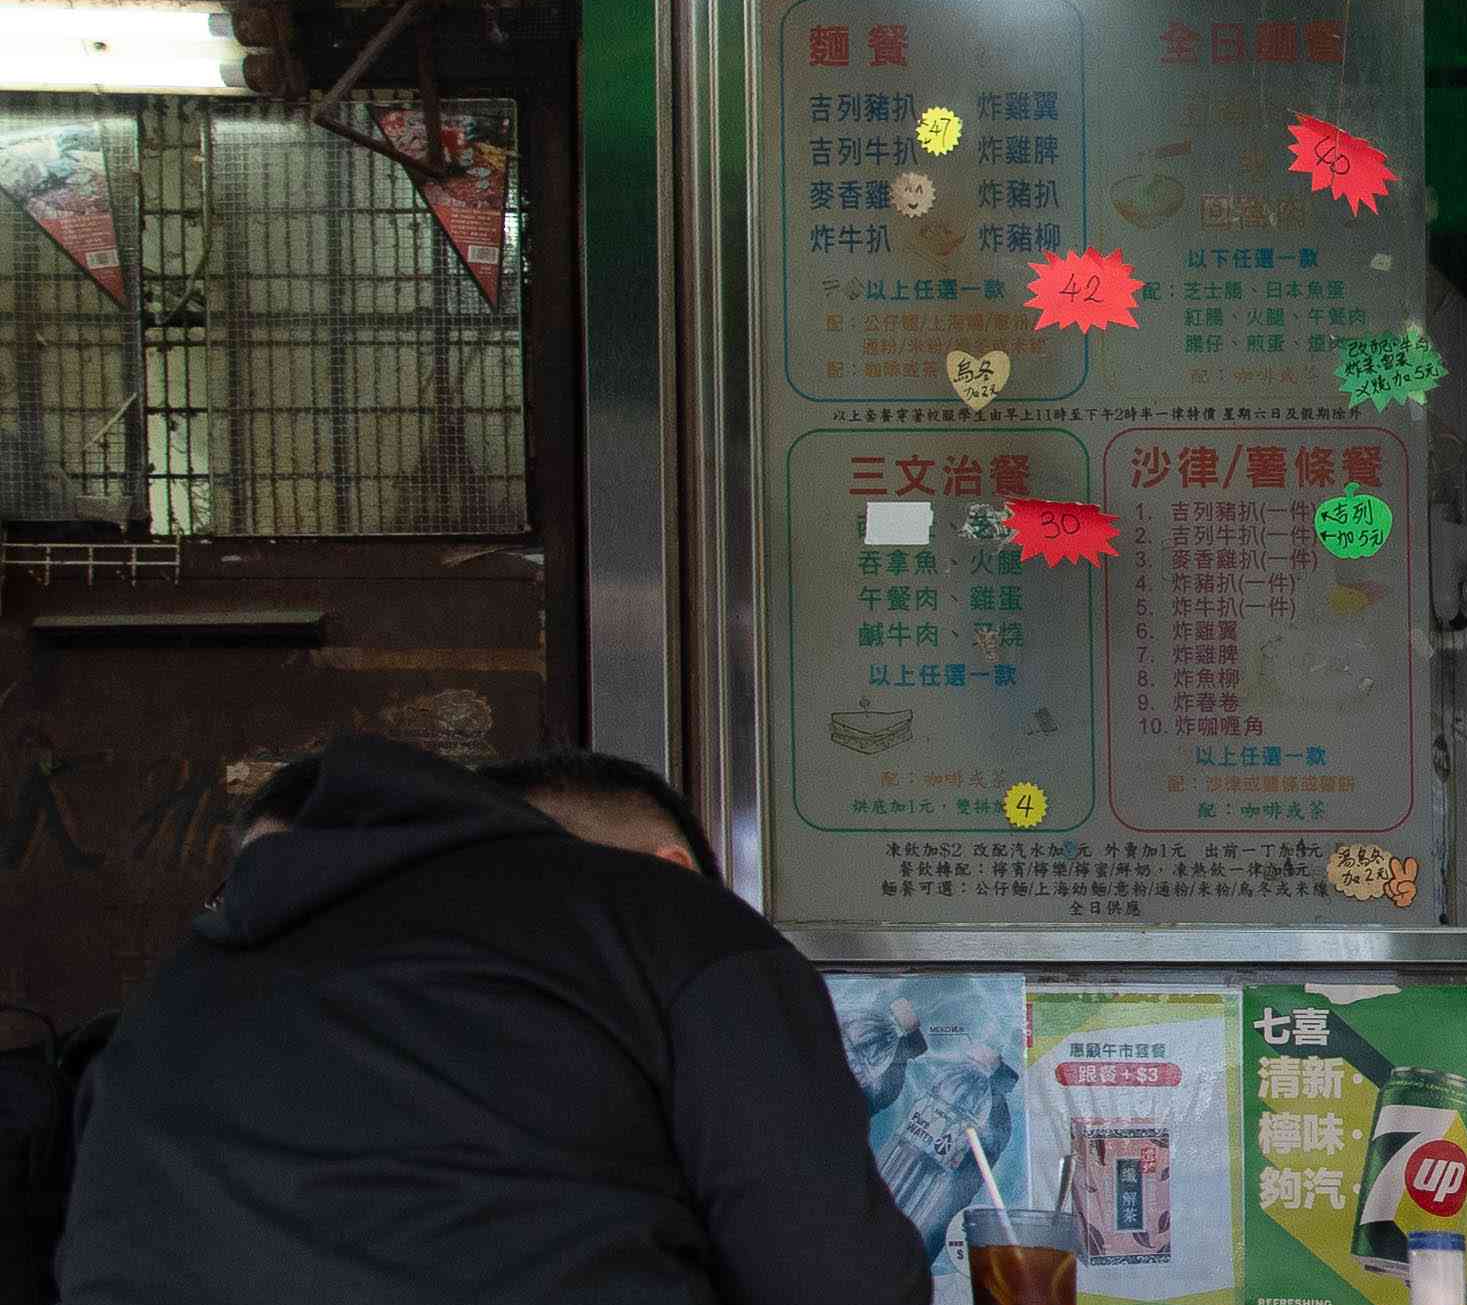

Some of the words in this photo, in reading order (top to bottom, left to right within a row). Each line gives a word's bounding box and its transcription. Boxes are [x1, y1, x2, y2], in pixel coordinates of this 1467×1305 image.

[809, 94, 917, 124] 吉列豬扒
[977, 94, 1059, 124] 炸雞翼
[809, 137, 918, 167] 吉列牛扒
[977, 137, 1060, 167] 炸雞脾
[977, 181, 1060, 210] 炸豬扒
[809, 223, 892, 255] 炸牛扒
[977, 223, 1061, 255] 炸豬柳
[1059, 273, 1105, 303] 42
[848, 454, 1031, 497] 三文治餐
[1130, 443, 1384, 491] 沙律/薯條餐
[1040, 511, 1081, 539] 30
[1015, 793, 1035, 818] 4
[1253, 1007, 1331, 1046] 七喜
[1257, 1055, 1346, 1099] 清新
[1257, 1112, 1346, 1155] 檸味
[1258, 1166, 1347, 1210] 夠汽
